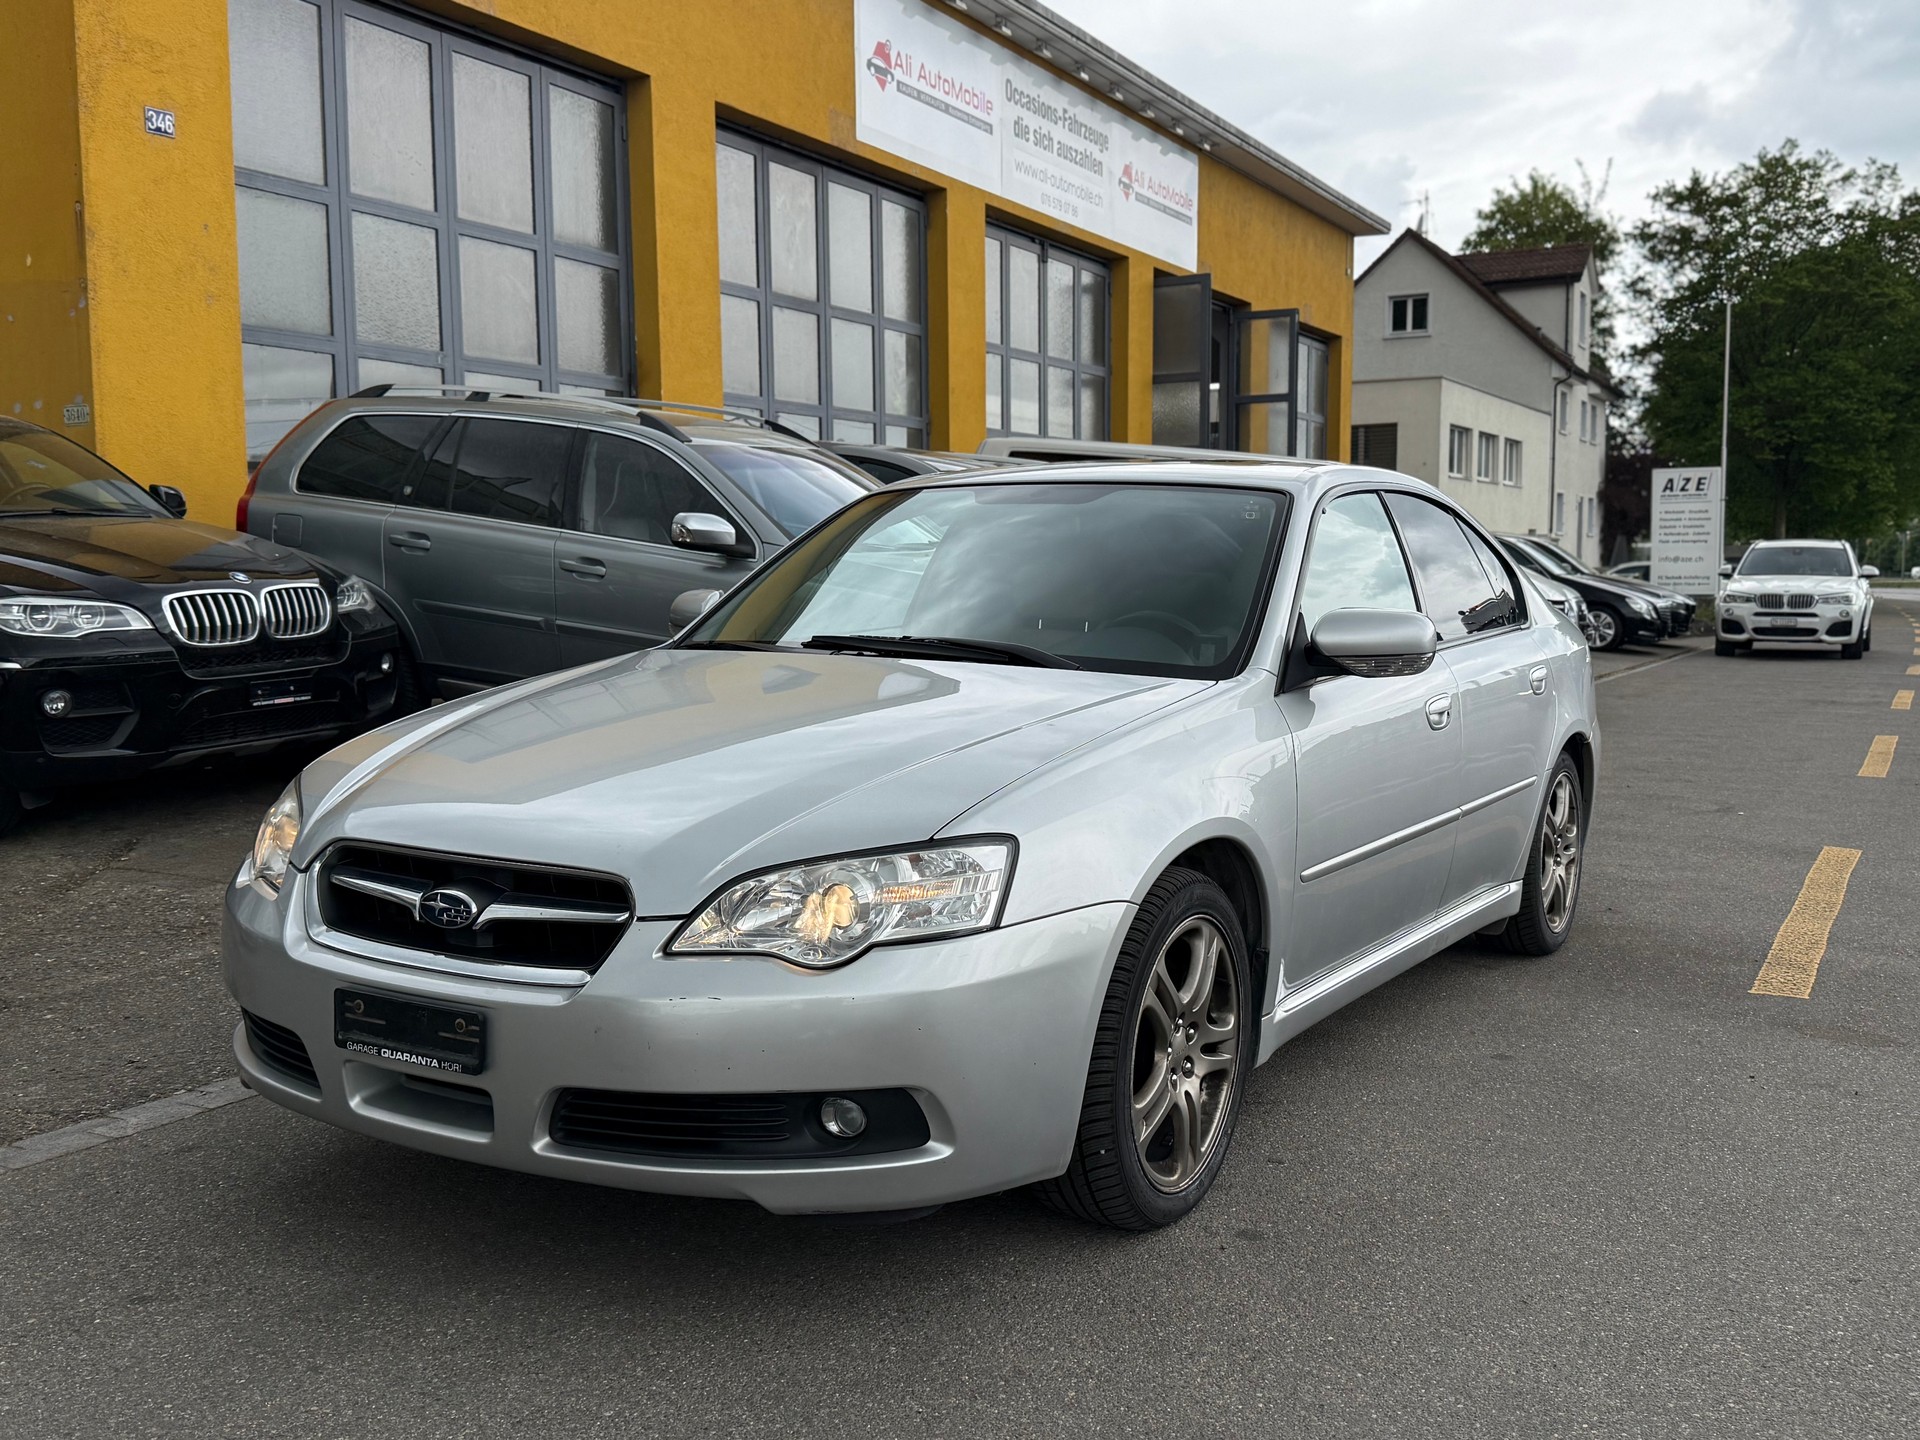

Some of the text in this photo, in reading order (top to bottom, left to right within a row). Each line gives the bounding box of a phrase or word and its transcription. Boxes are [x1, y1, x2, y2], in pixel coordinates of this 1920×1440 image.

[894, 50, 993, 116] Ali AutoMobile
[148, 110, 173, 133] 346
[1005, 78, 1109, 153] Occasions-Fahrzeuge
[1013, 116, 1104, 177] die sich auszahlen
[1133, 168, 1145, 189] Ali
[1147, 175, 1193, 212] AutoMobile
[1658, 555, 1704, 564] info@aze.ch
[346, 1041, 379, 1056] GARAGE
[380, 1048, 439, 1068] QUARANTA
